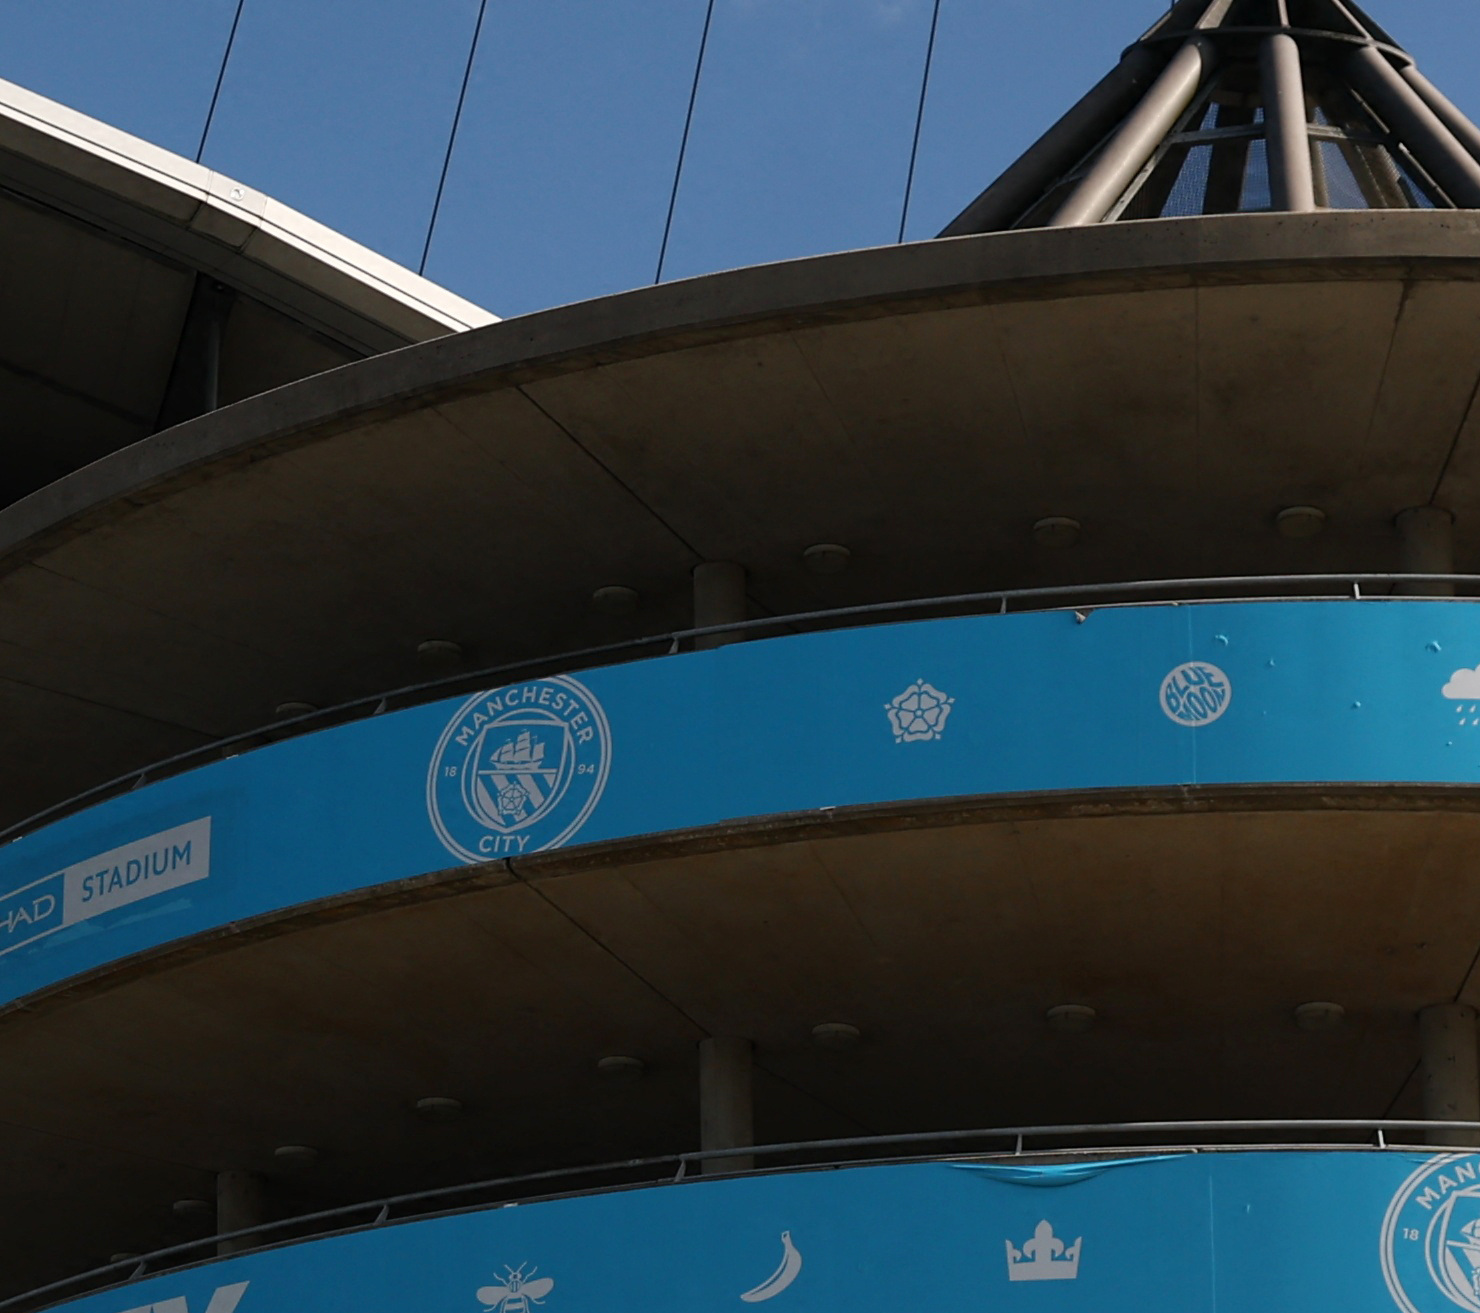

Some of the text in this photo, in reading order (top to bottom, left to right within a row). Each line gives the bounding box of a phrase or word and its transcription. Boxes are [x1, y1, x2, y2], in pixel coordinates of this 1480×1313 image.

[1166, 666, 1225, 715] BLUE
[1177, 686, 1226, 721] MOON
[455, 686, 594, 746] MANCHESTER
[444, 764, 595, 778] 18 94
[478, 835, 531, 853] CITY
[81, 840, 193, 903] STADIUM
[1402, 1228, 1420, 1241] 18
